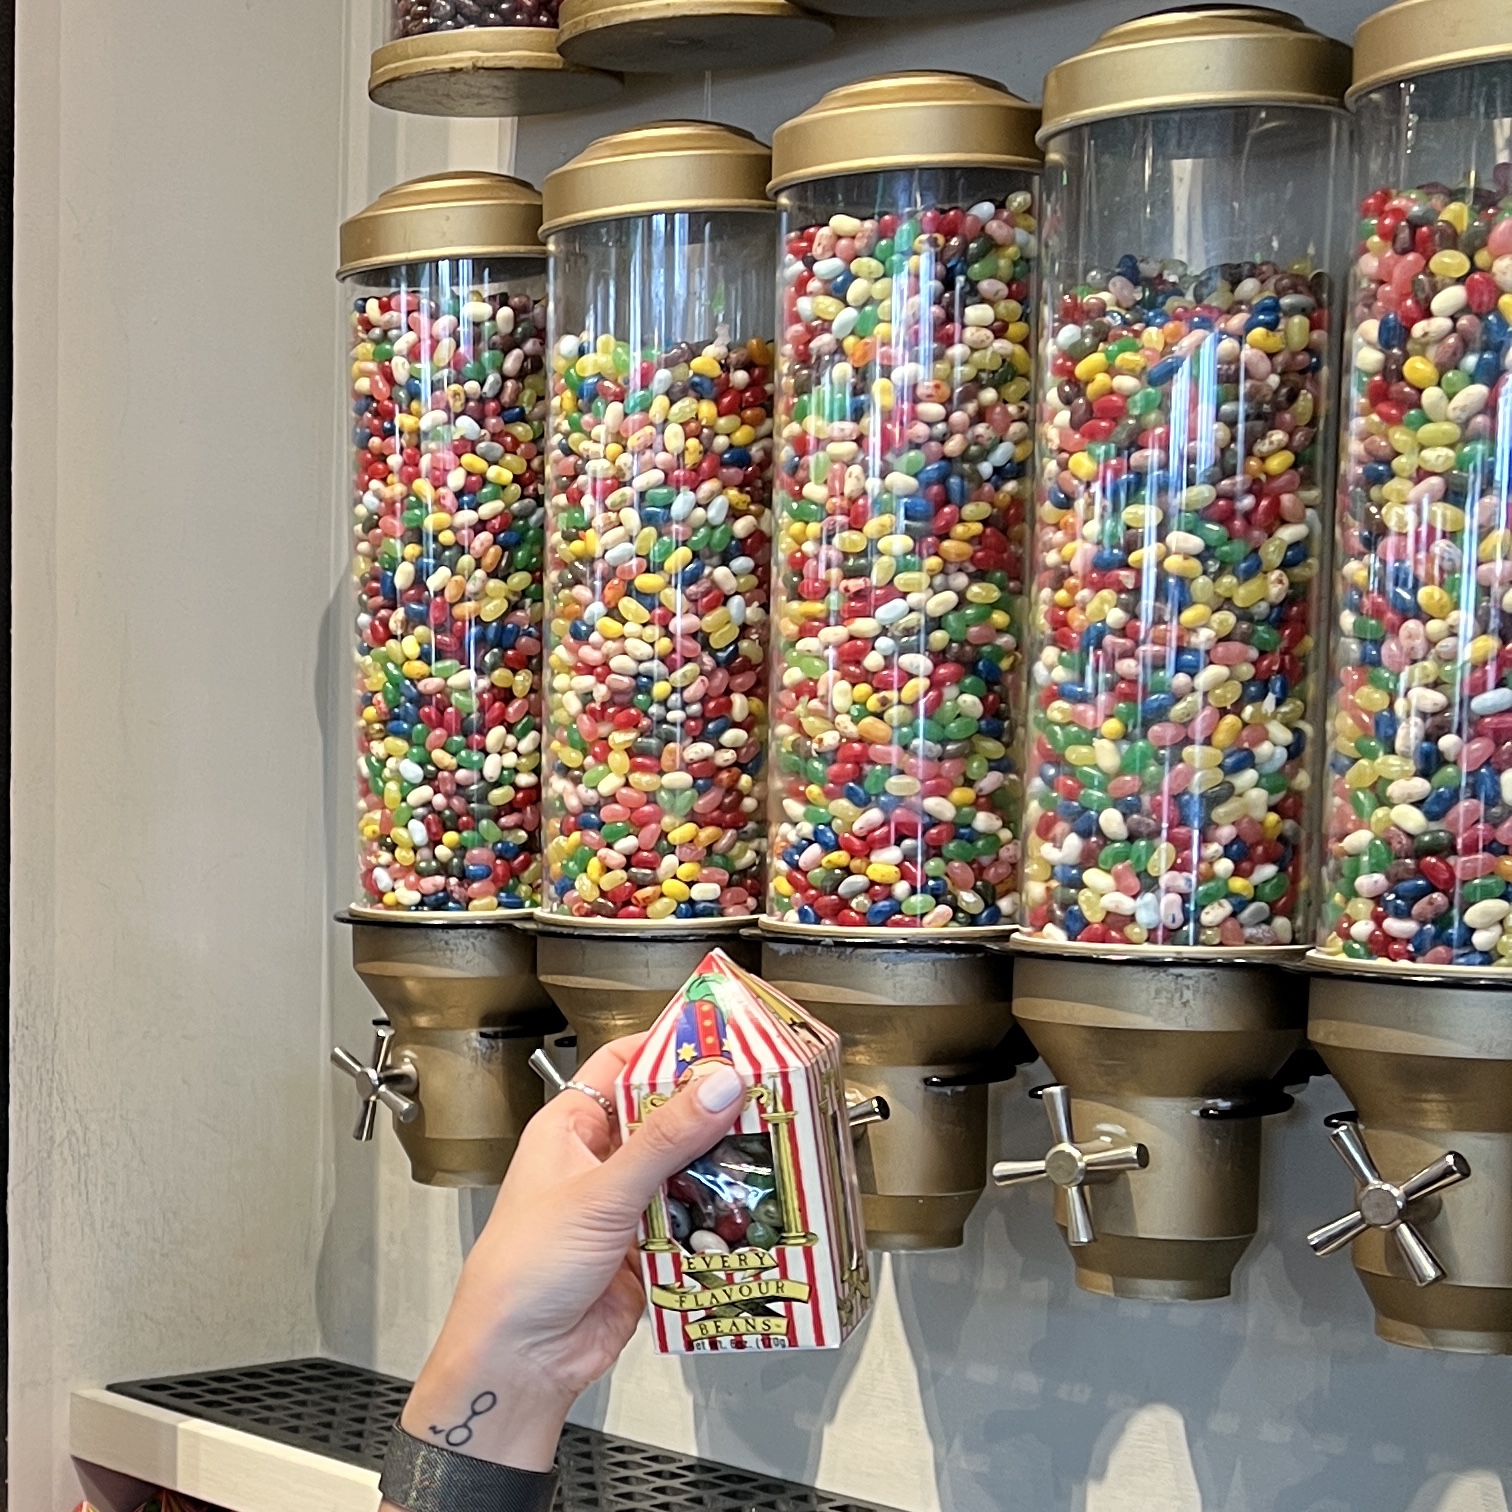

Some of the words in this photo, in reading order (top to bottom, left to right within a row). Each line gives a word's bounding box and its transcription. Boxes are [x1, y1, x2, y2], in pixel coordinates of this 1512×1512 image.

[687, 1252, 766, 1270] EVERY
[679, 1281, 785, 1308] FLAVOUR
[699, 1318, 771, 1336] BEANS
